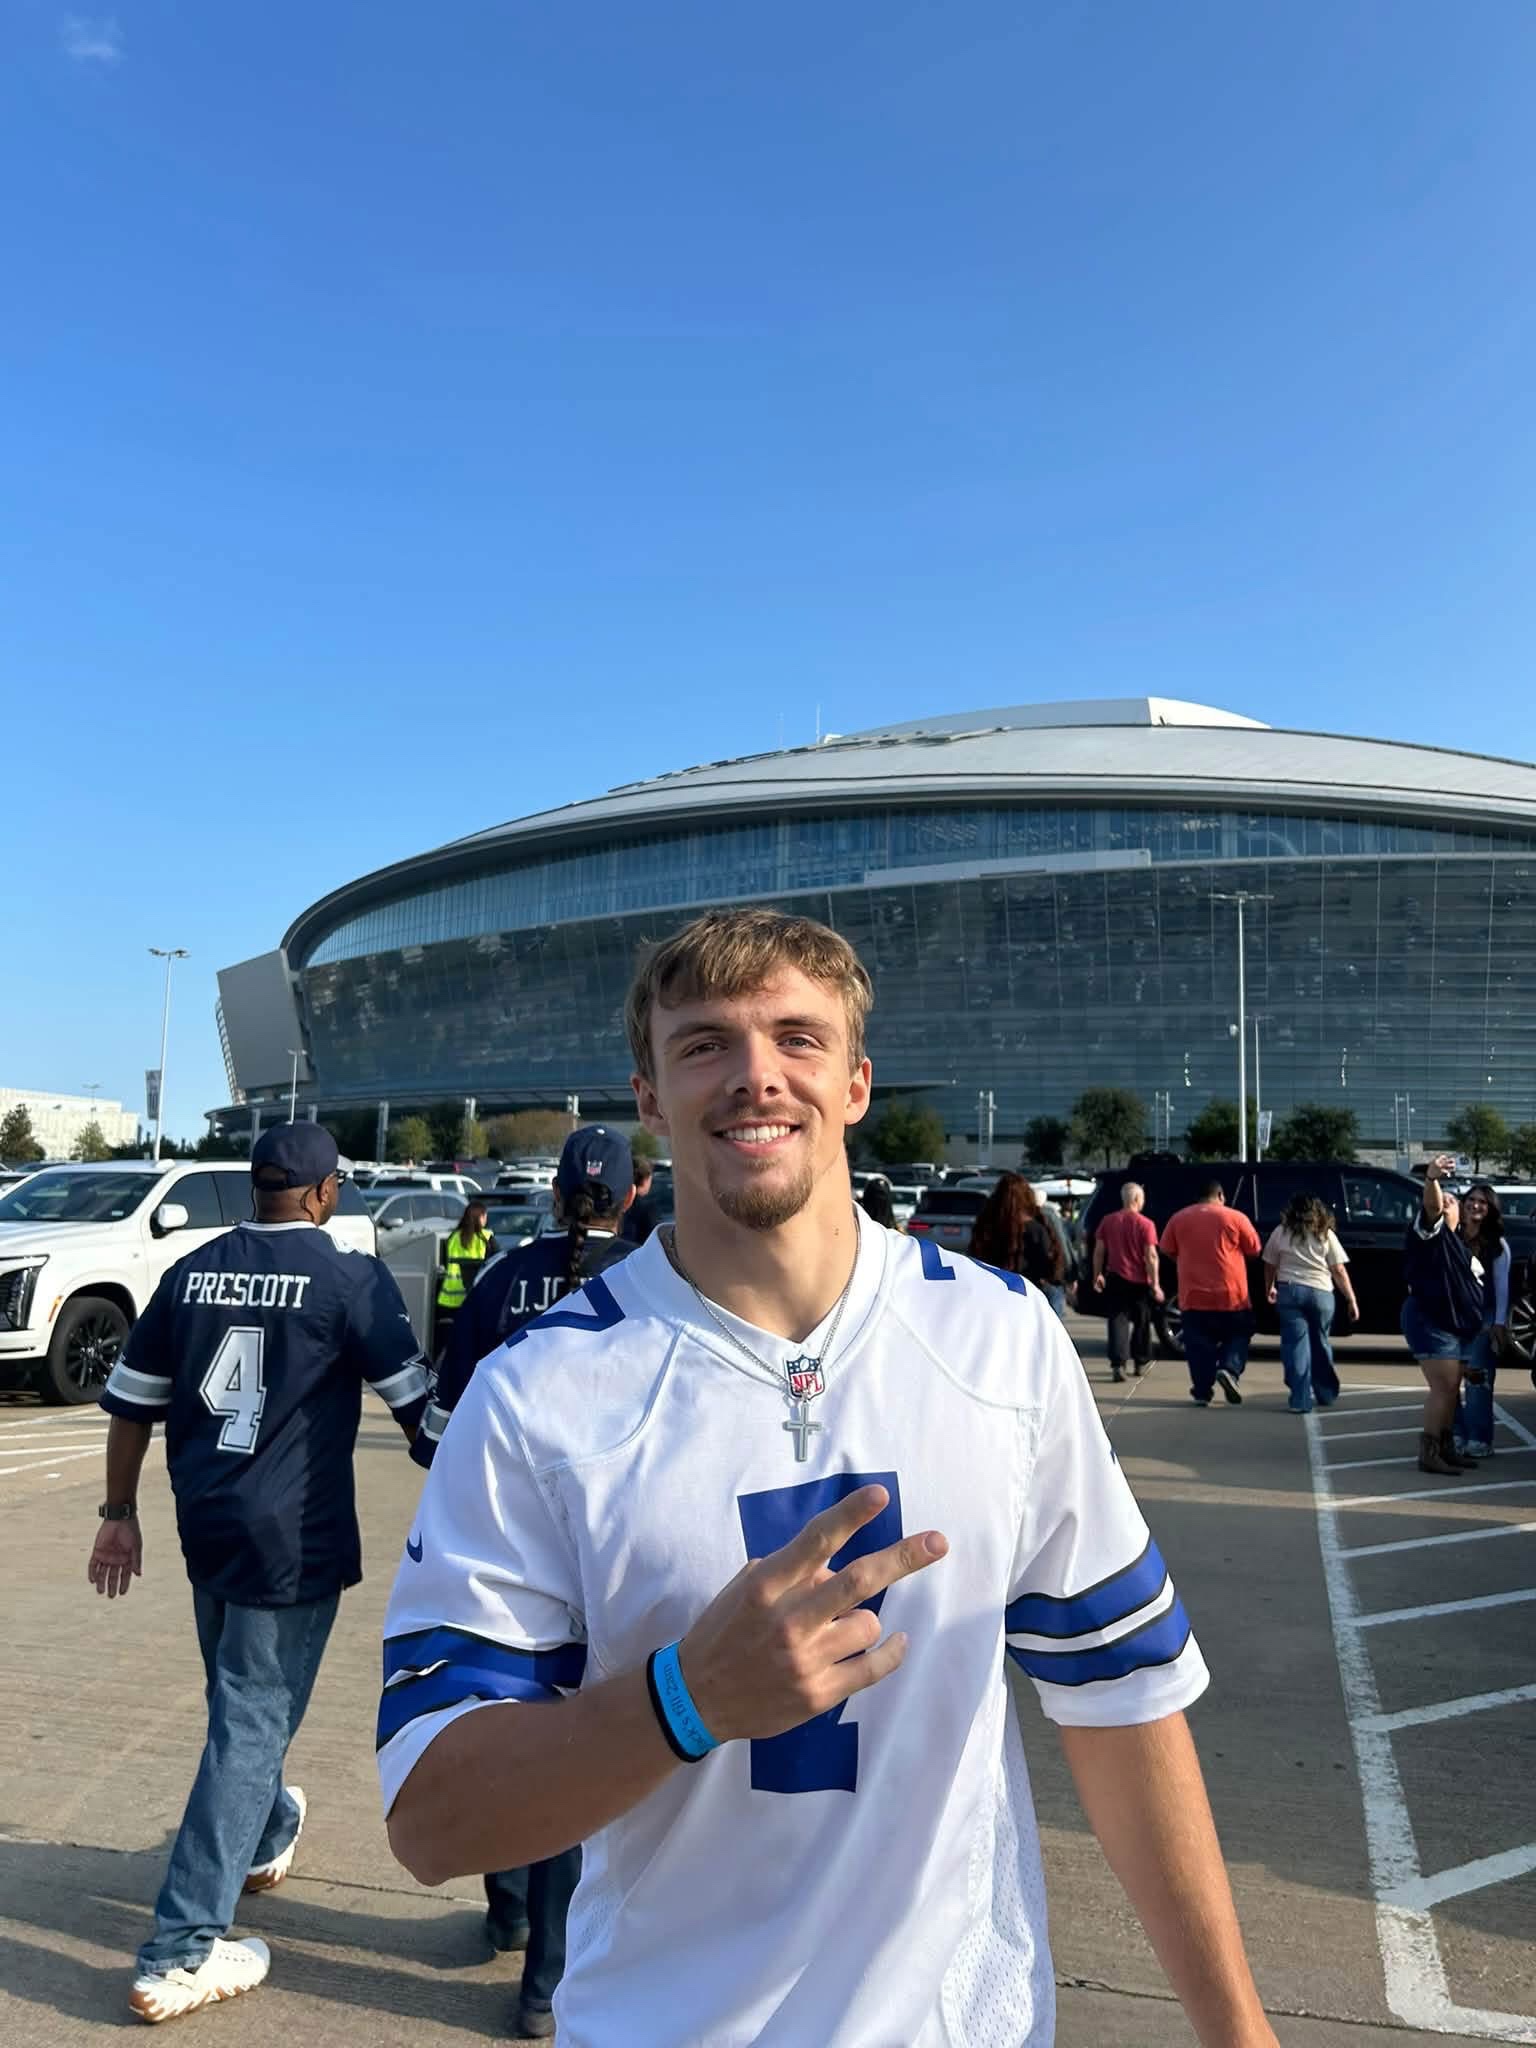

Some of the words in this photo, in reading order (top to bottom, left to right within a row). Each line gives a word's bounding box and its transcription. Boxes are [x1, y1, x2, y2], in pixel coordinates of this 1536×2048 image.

[183, 1272, 311, 1308] PRESCOTT
[199, 1326, 267, 1454] 4
[792, 1372, 822, 1395] NFL
